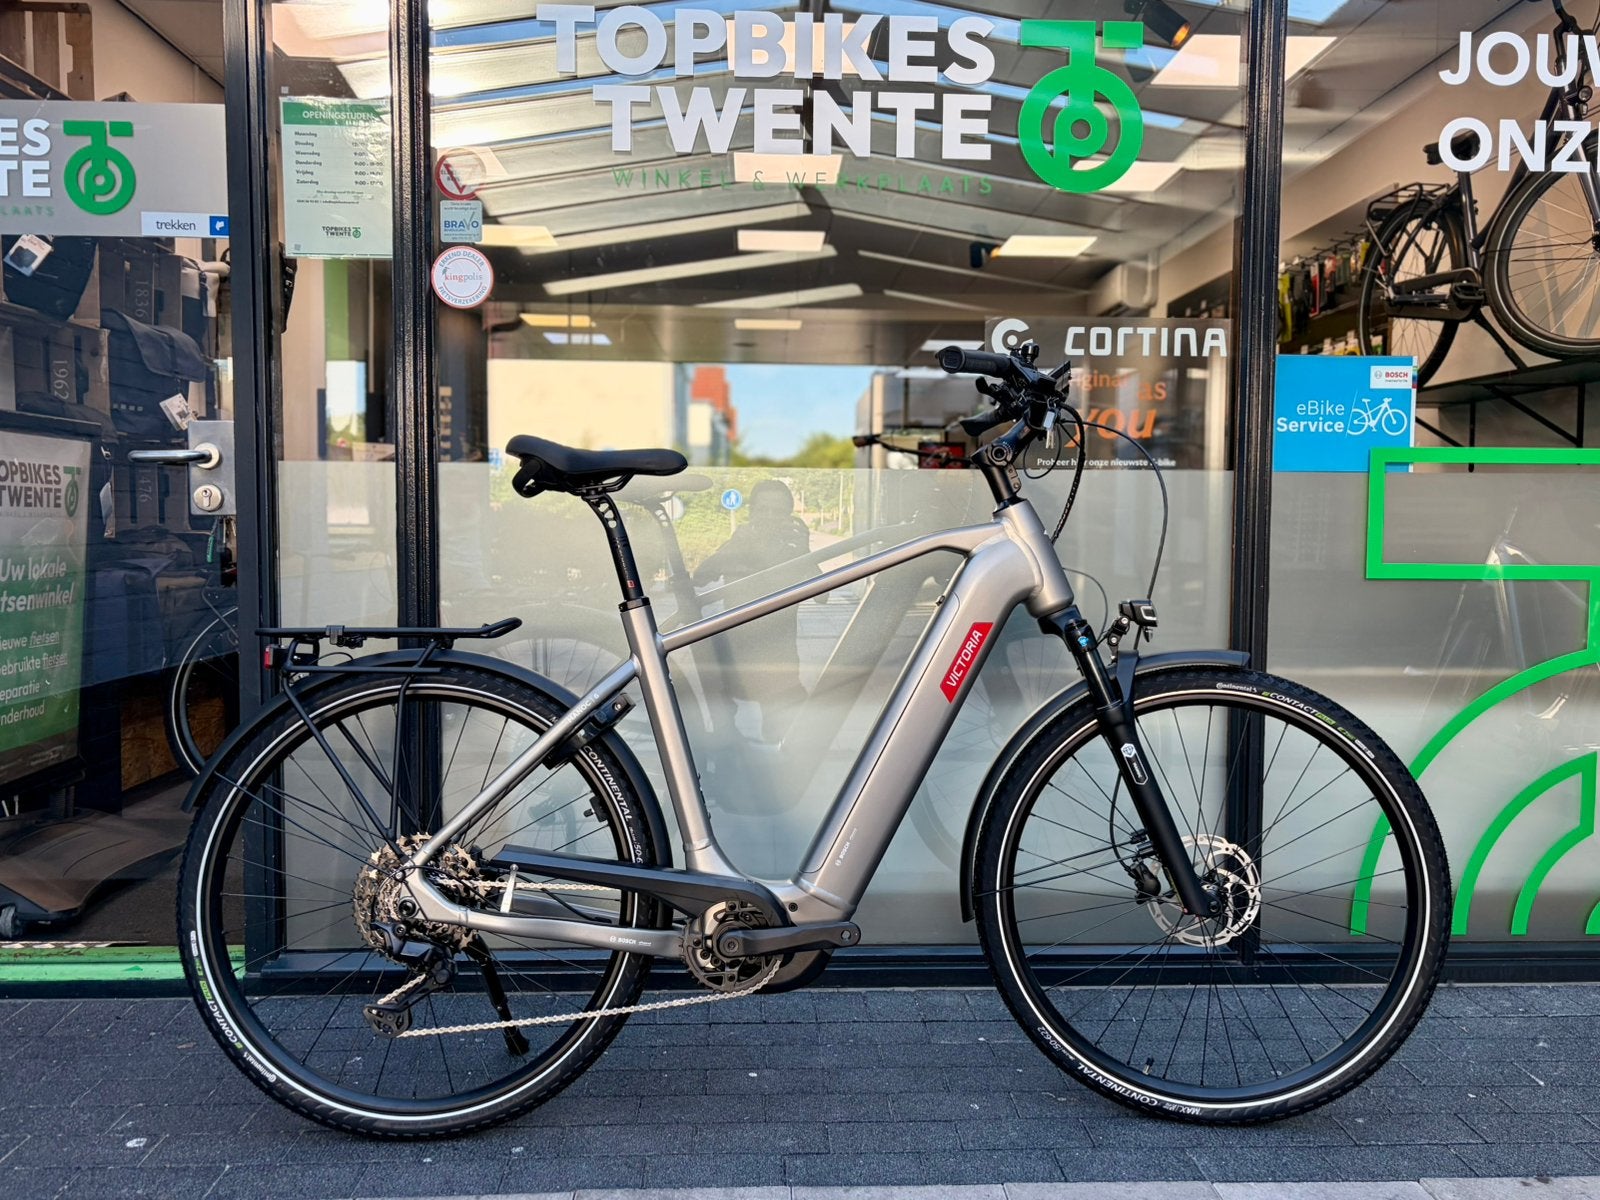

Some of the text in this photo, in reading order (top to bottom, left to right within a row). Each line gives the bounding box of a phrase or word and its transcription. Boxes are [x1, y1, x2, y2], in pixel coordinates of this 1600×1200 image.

[536, 4, 996, 85] TOPBIKES
[592, 84, 992, 161] TWENTE
[1438, 116, 1600, 173] ONZ
[612, 167, 992, 195] WINKEL & WERKPLAATS
[156, 219, 196, 231] trekken
[444, 214, 479, 229] BRAVO
[462, 251, 484, 267] DEALER
[444, 272, 483, 283] kingpolis
[1064, 326, 1228, 357] CORTINA
[1296, 400, 1345, 416] eBike
[1276, 416, 1345, 433] Service
[0, 555, 67, 582] Uw lokale
[0, 656, 41, 675] ebruikte
[946, 629, 983, 687] VICTORIA
[583, 745, 633, 822] CONTINENTAL
[618, 937, 637, 945] BOSCH
[1077, 1063, 1159, 1107] CONTINENTAL
